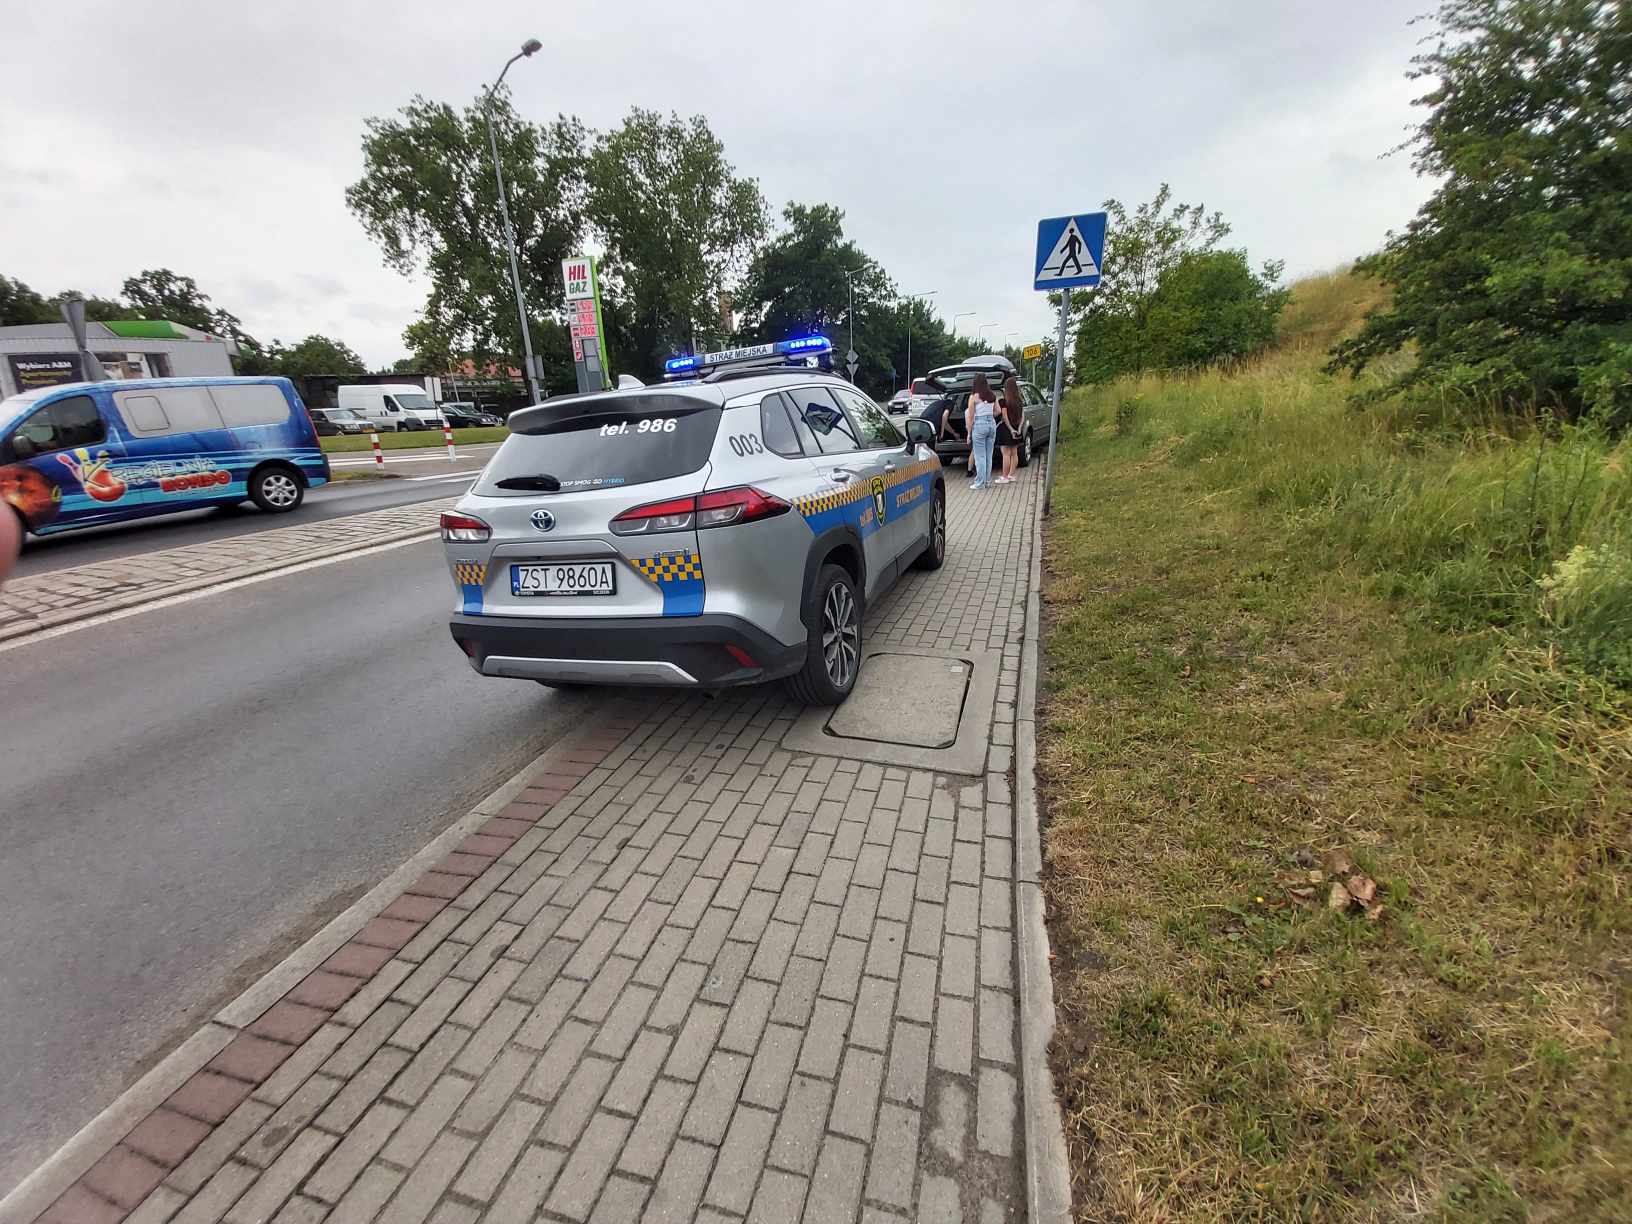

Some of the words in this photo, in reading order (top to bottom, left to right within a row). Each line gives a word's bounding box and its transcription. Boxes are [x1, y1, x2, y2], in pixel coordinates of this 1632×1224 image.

[569, 264, 587, 281] HIL
[569, 281, 587, 294] GAZ
[735, 346, 768, 358] MIEJSKA
[600, 421, 629, 436] tel.
[637, 418, 677, 434] 986
[728, 433, 764, 457] 003
[520, 568, 550, 589] ZST
[556, 566, 610, 589] 9860A
